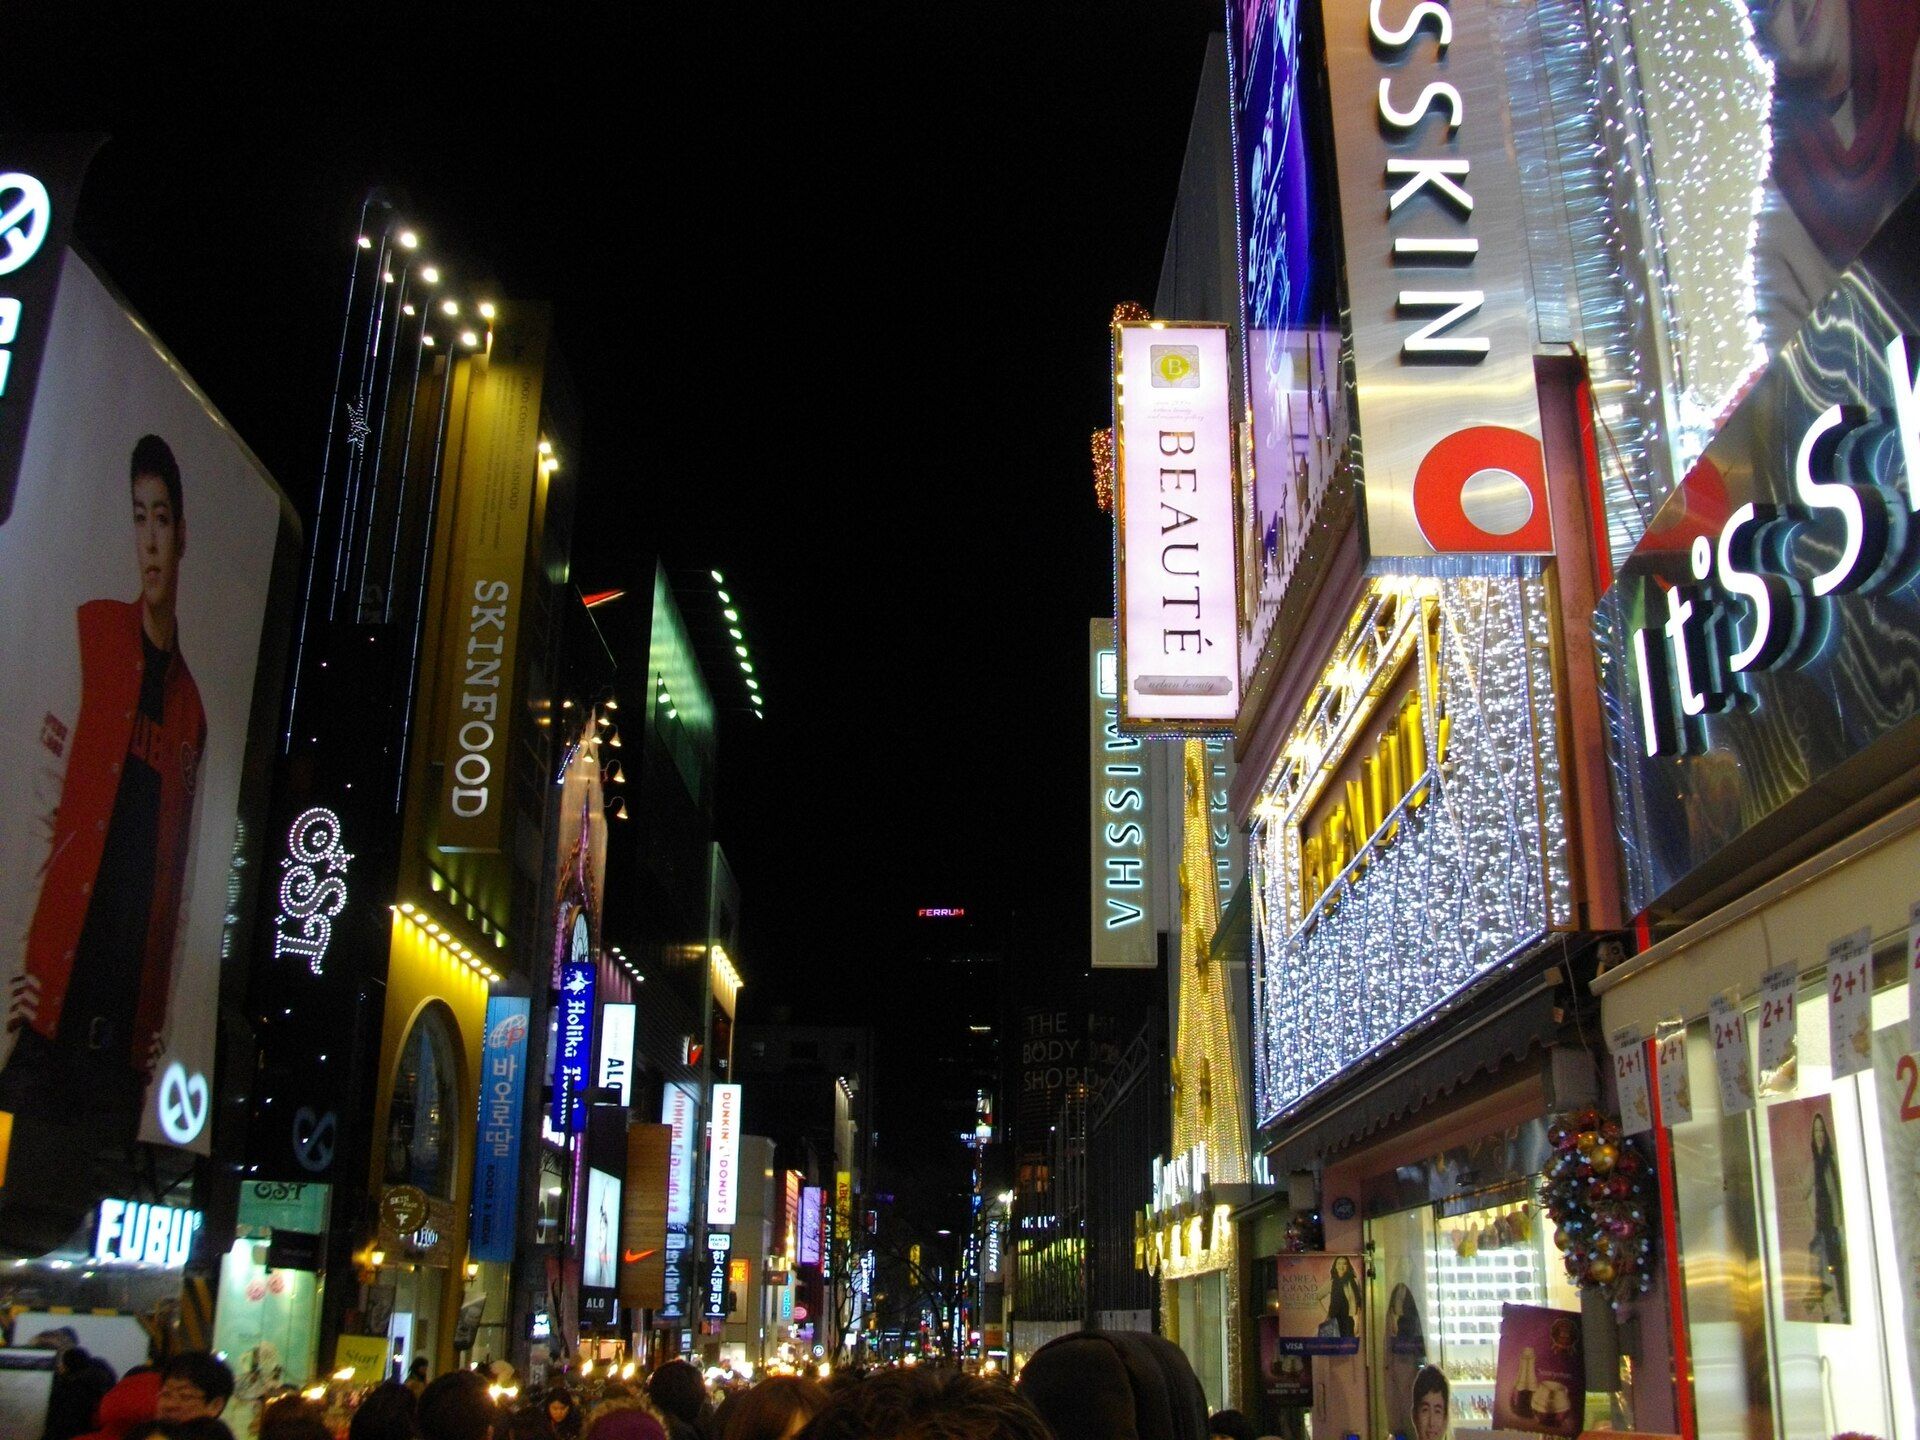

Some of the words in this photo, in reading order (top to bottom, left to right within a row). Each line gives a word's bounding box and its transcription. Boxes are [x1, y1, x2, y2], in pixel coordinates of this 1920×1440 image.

[1157, 430, 1214, 655] BEAUTÉ
[451, 579, 511, 818] SKINFOOD
[918, 908, 965, 918] FERRUM
[1831, 963, 1869, 1005] 2+1
[1027, 1012, 1069, 1035] THE
[1762, 993, 1793, 1030] 2+1
[1714, 1018, 1742, 1050] 2+1
[1023, 1038, 1081, 1065] BODY
[1617, 1049, 1642, 1079] 2+1
[1660, 1036, 1684, 1066] 2+1
[1024, 1066, 1077, 1091] SHOP
[485, 1054, 518, 1158] 바오로딸
[717, 1159, 729, 1214] DONUTS
[1282, 1274, 1317, 1283] KOREA
[585, 1297, 605, 1309] ALO
[1284, 1342, 1304, 1350] VISA
